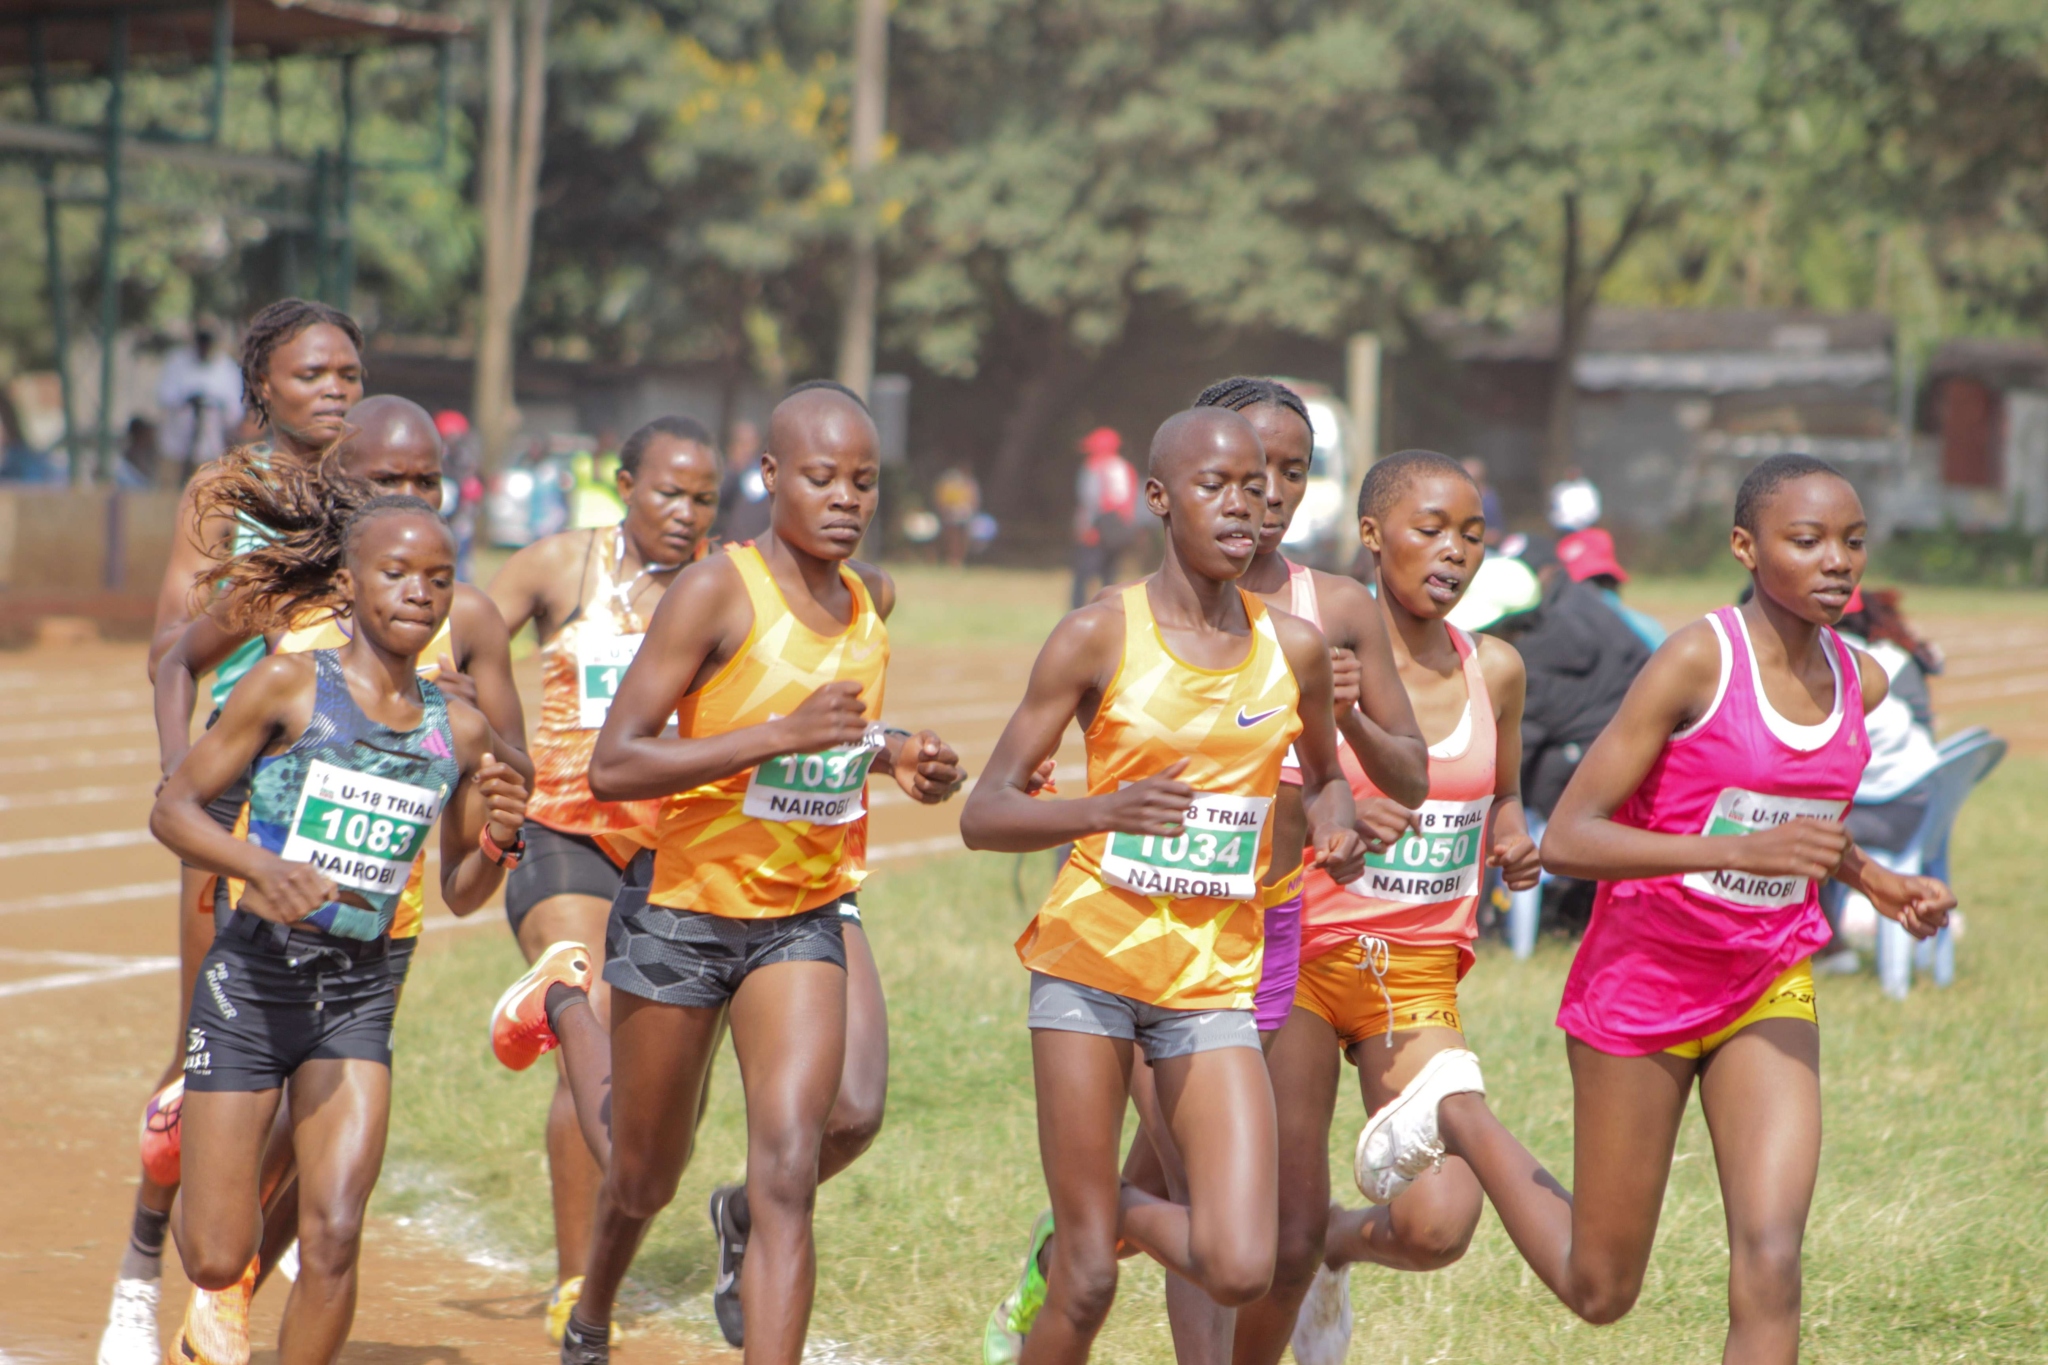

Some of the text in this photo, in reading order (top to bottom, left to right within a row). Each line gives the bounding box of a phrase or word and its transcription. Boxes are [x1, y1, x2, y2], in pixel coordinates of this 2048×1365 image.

[780, 753, 863, 789] 1032
[341, 785, 382, 807] U-18
[387, 796, 433, 819] TRIAL
[770, 795, 850, 817] NAIROBI
[1206, 808, 1258, 826] TRIAL
[1442, 810, 1482, 828] TRIAL
[1752, 808, 1790, 826] U-18
[321, 808, 416, 856] 1083
[1141, 832, 1242, 868] 1034
[309, 850, 396, 884] NAIROBI
[1127, 868, 1231, 897] NAIROBI
[1371, 874, 1461, 895] NAIROBI
[1712, 869, 1797, 898] NAIROBI
[214, 962, 230, 981] PB
[205, 969, 238, 1020] RUNNER
